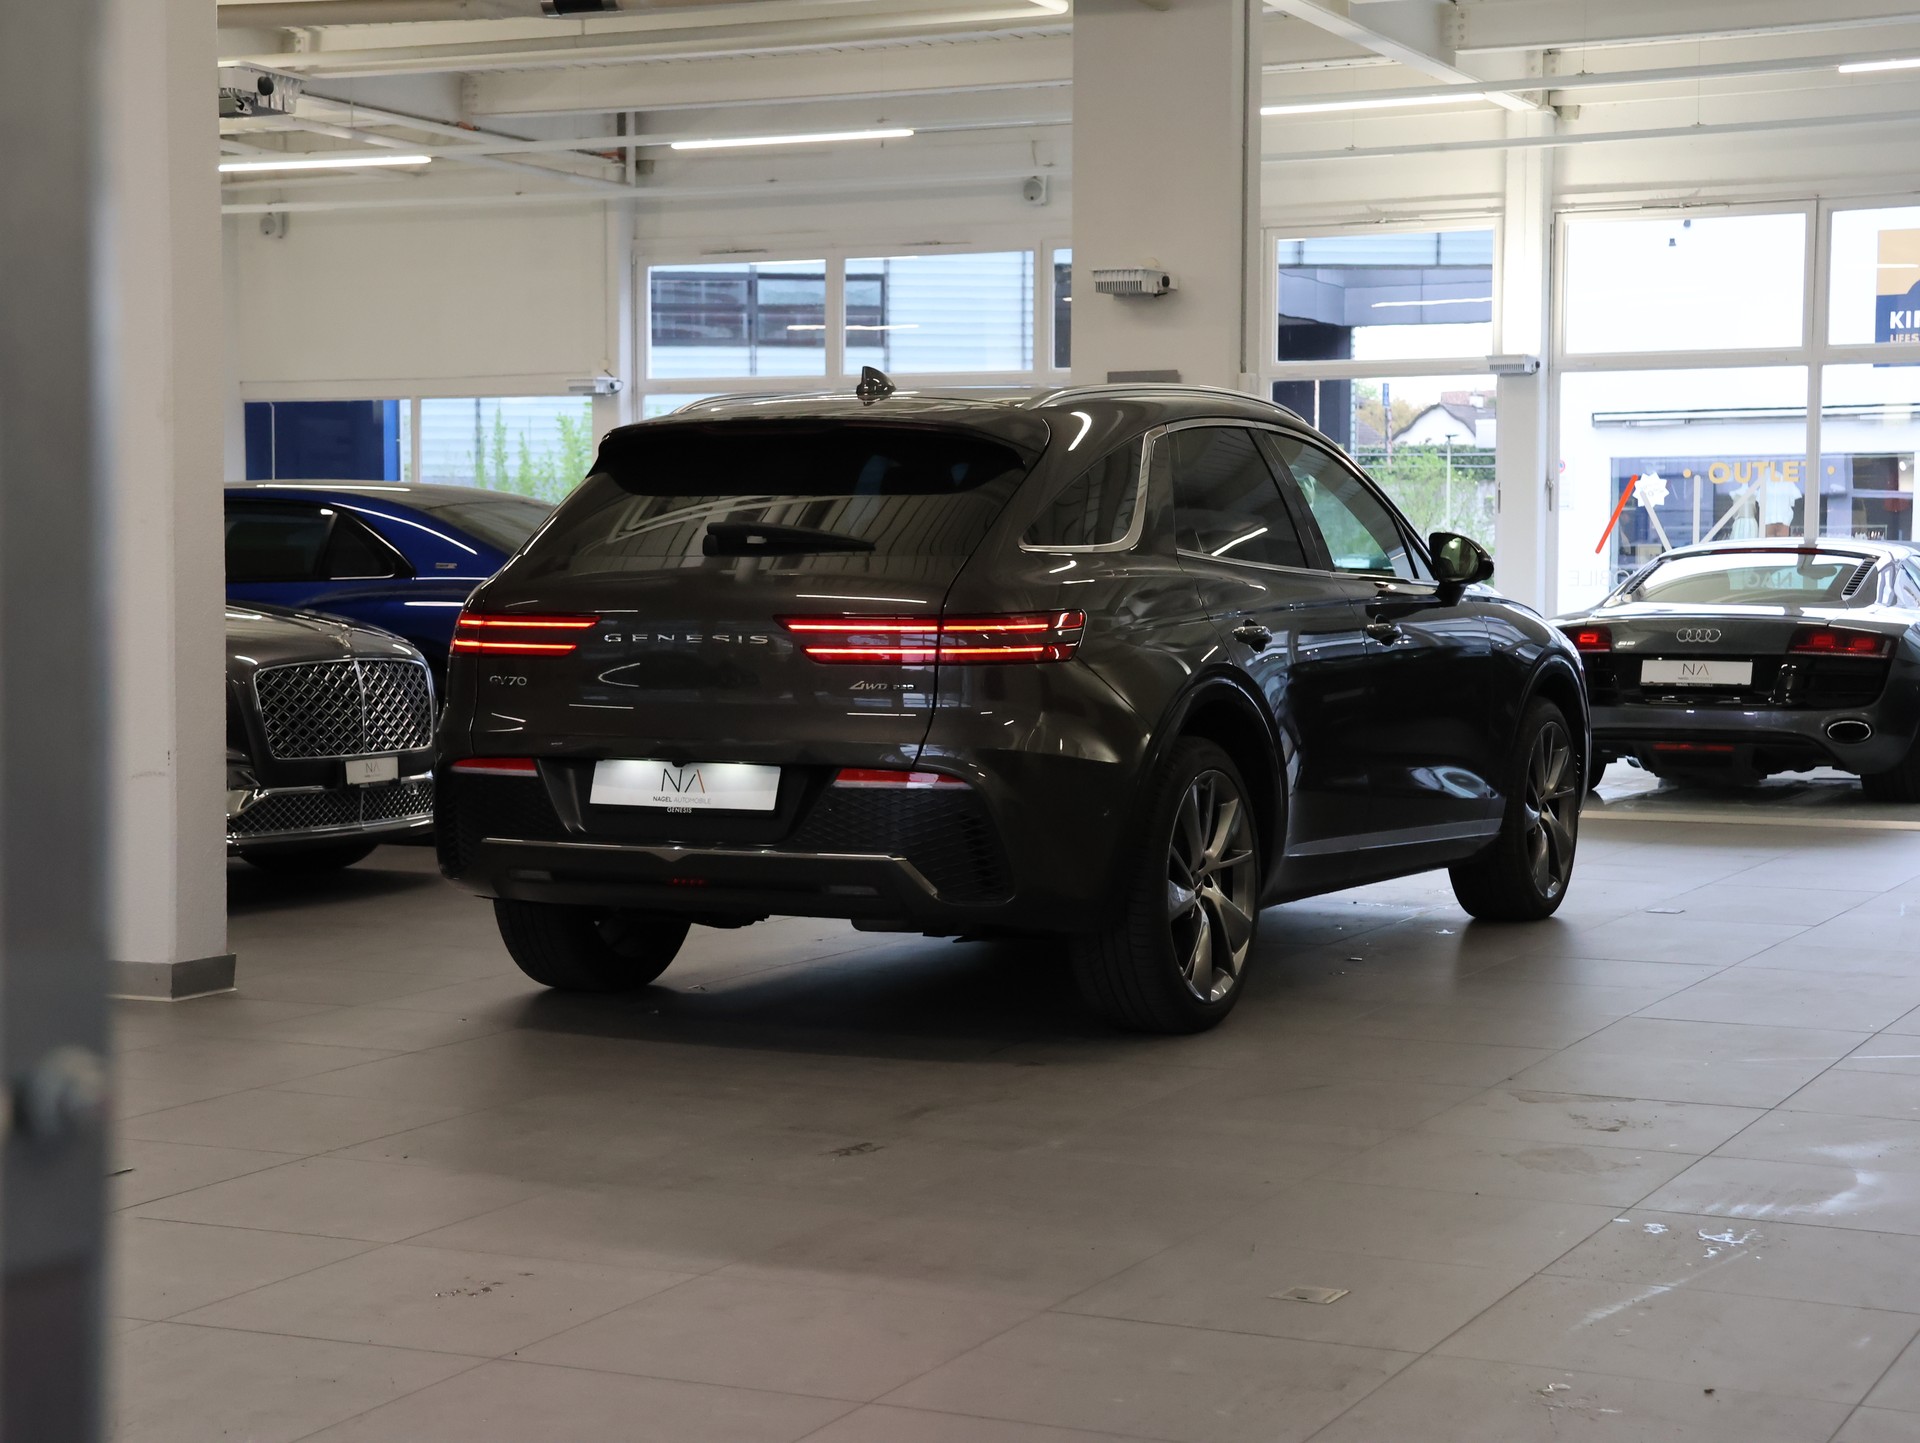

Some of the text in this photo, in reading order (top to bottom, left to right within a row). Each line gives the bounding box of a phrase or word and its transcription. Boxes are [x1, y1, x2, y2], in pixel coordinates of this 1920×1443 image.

[1708, 461, 1808, 485] OUTLE
[603, 632, 769, 645] GENESIS
[489, 674, 528, 687] GV70
[661, 767, 706, 794] NA
[674, 797, 712, 805] AUTOMOBILE
[666, 806, 692, 814] GENESIS
